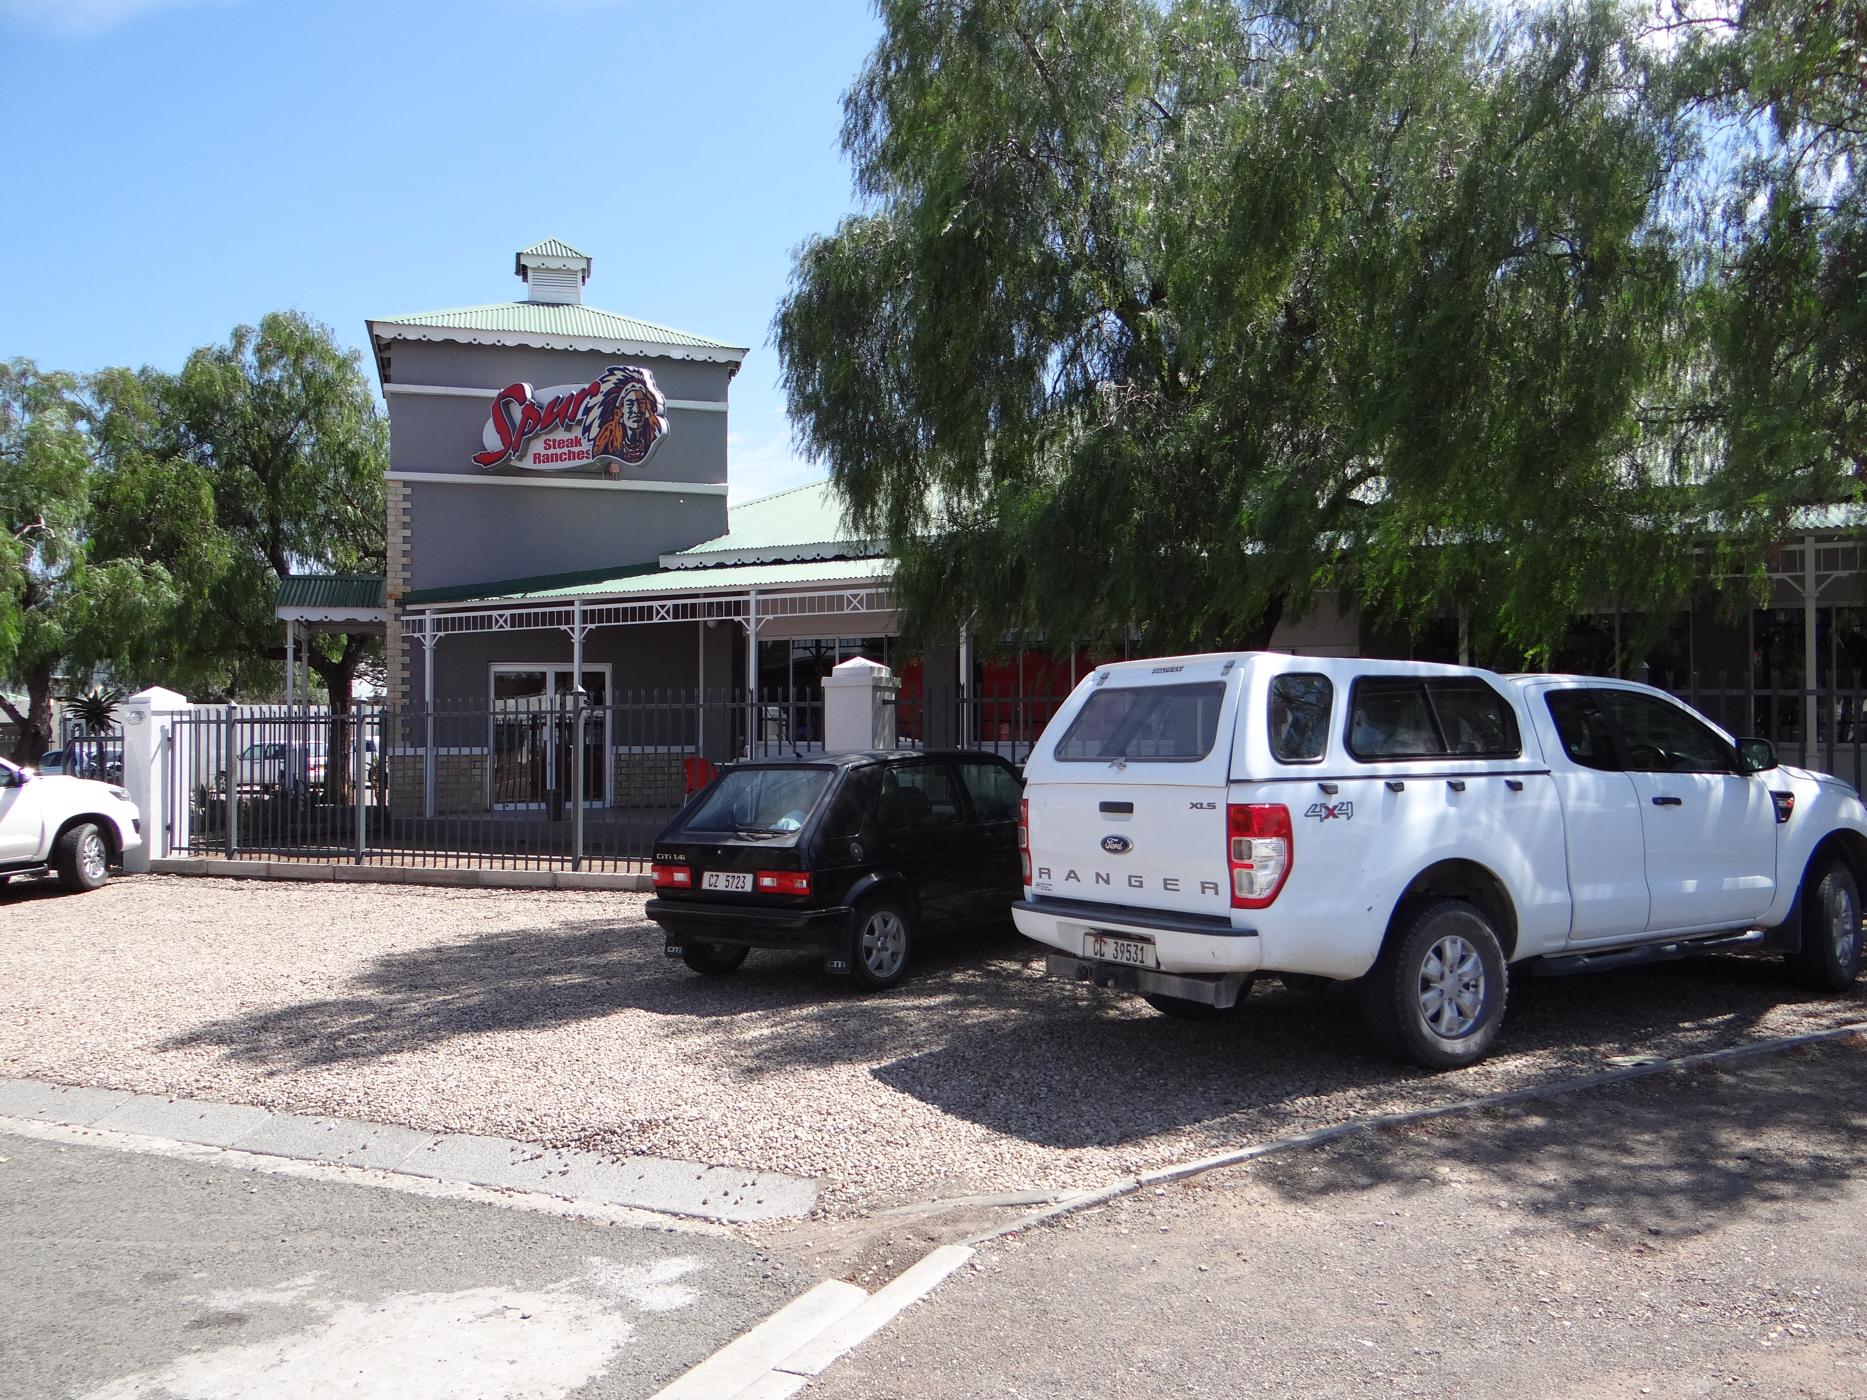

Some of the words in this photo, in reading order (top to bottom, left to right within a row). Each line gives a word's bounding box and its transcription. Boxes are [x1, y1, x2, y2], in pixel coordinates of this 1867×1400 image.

[473, 382, 601, 468] Spur
[543, 436, 583, 451] Steak
[532, 449, 591, 465] Ranches
[1189, 802, 1217, 810] XLS
[1104, 837, 1124, 850] Ford
[708, 874, 720, 888] CZ
[724, 875, 747, 889] 5723
[1038, 866, 1220, 896] RANGER
[1112, 941, 1145, 964] 39531
